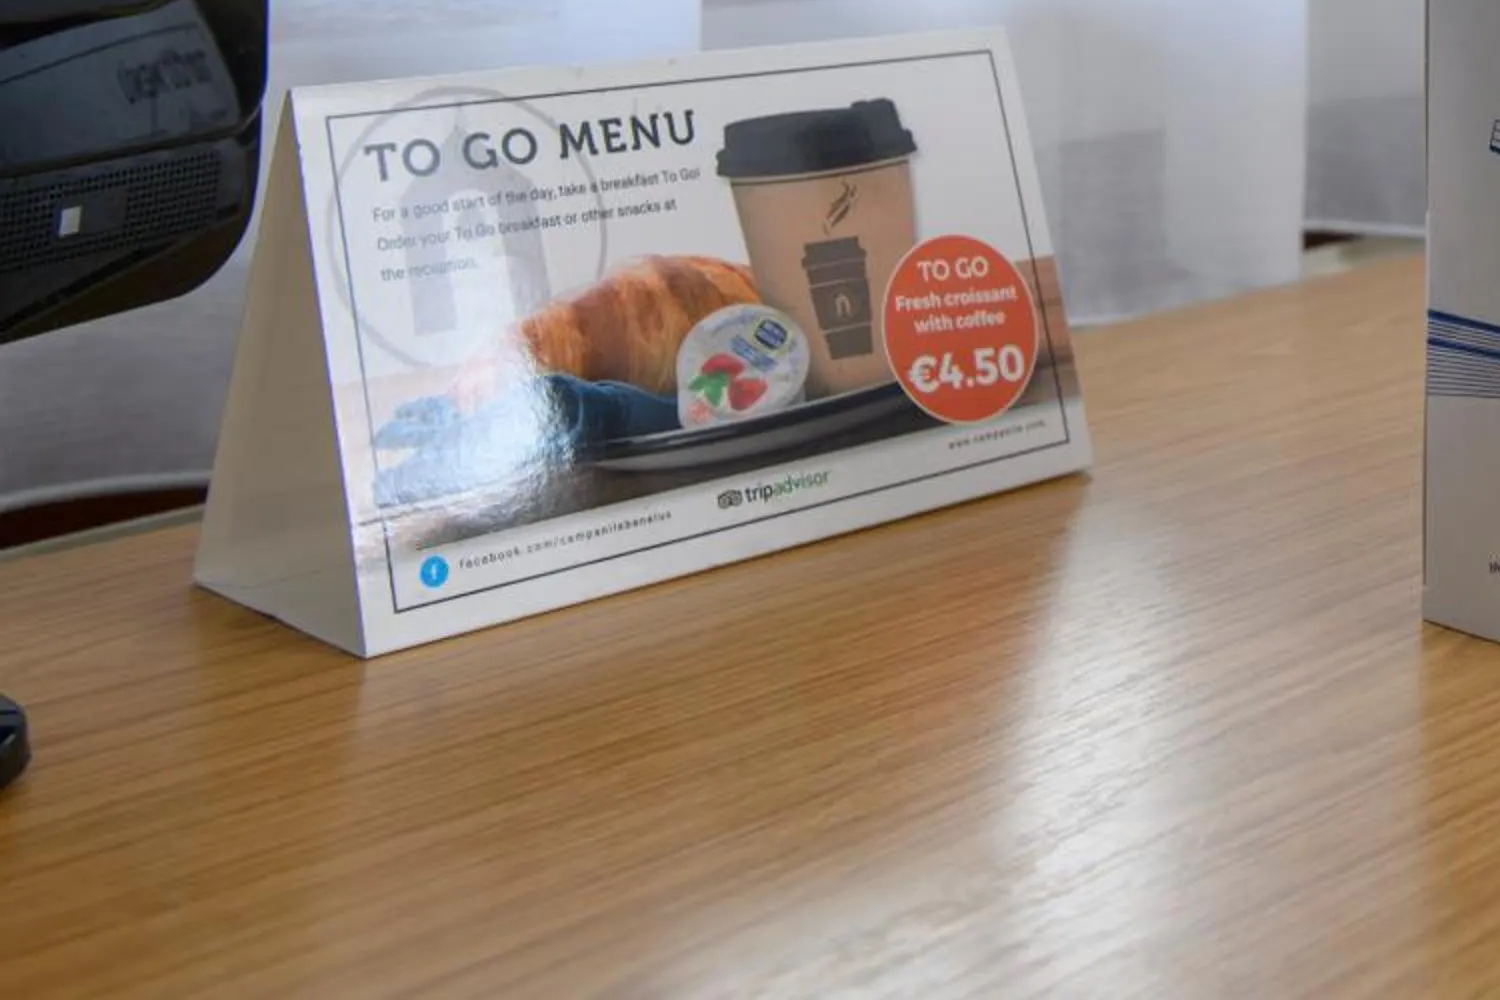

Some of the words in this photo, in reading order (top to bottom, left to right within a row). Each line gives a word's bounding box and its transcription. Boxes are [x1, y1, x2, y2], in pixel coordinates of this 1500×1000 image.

[363, 138, 441, 182] TO
[462, 127, 538, 171] GO
[559, 109, 694, 160] MENU
[373, 207, 396, 223] For
[400, 206, 409, 217] a
[413, 201, 449, 219] good
[452, 195, 485, 210] start
[487, 192, 502, 205] of
[504, 190, 527, 203] the
[558, 183, 587, 198] take
[600, 174, 660, 192] breakfast
[661, 169, 678, 184] To
[377, 234, 416, 251] Order
[418, 230, 451, 248] your
[453, 226, 472, 240] To
[475, 222, 496, 237] Go
[498, 215, 561, 235] breakfast
[563, 212, 578, 226] or
[581, 208, 614, 223] other
[617, 200, 662, 218] snacks
[664, 198, 678, 211] at
[380, 266, 405, 282] the
[916, 259, 950, 282] TO
[955, 255, 989, 279] GO
[895, 291, 942, 312] Fresh
[944, 285, 1018, 308] croissant
[913, 313, 953, 334] with
[956, 309, 1005, 331] coffee
[908, 344, 1026, 394] €4.50
[744, 470, 831, 504] tripadvisor
